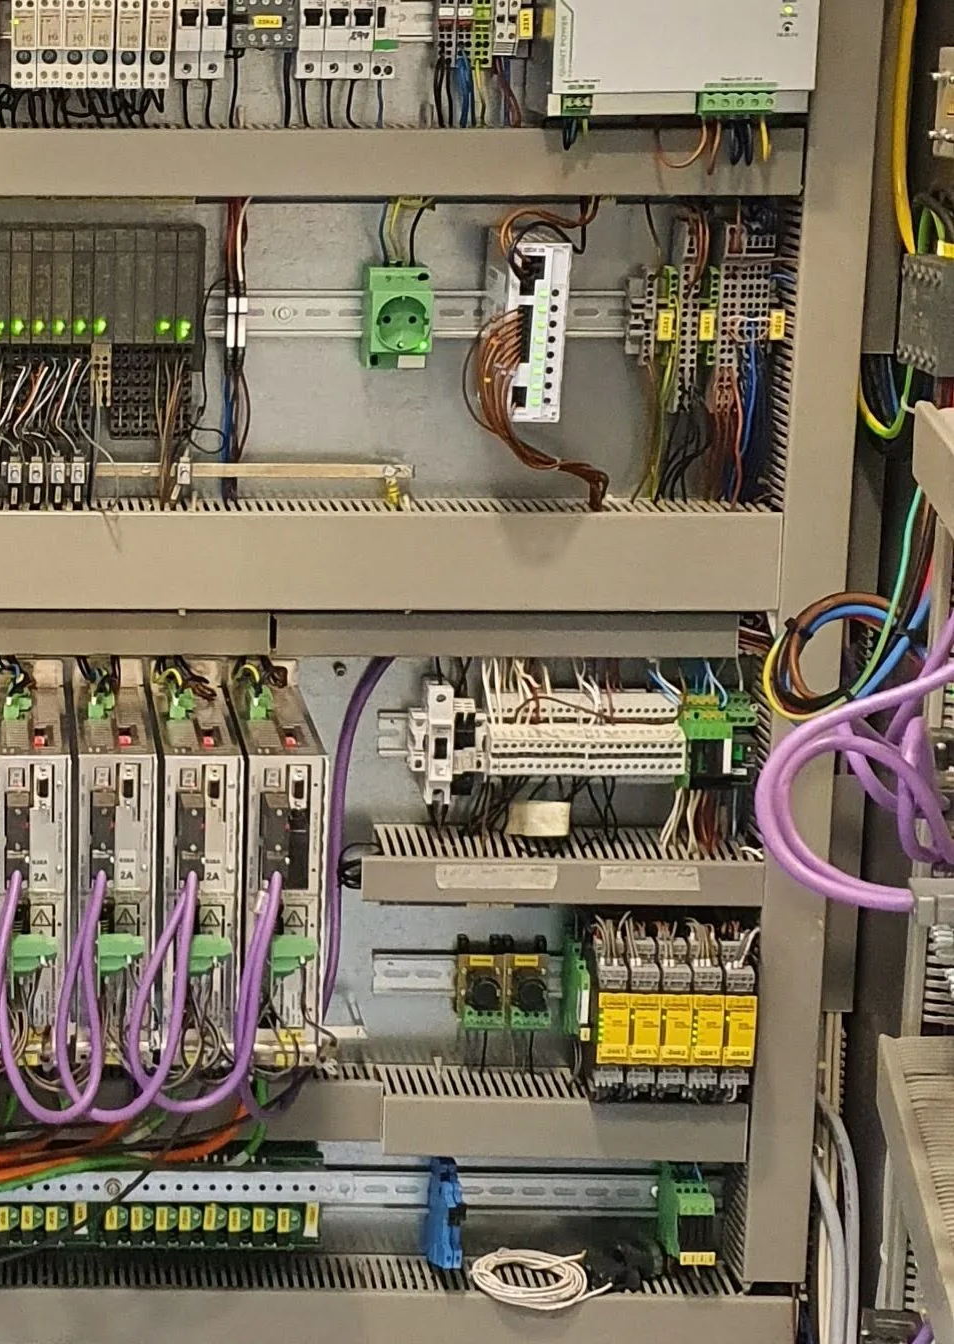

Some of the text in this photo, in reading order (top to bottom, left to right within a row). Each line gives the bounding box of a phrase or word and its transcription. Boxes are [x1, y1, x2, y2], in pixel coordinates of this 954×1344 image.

[33, 873, 47, 882] 2A
[120, 871, 134, 880] 2A
[206, 873, 220, 881] 2A
